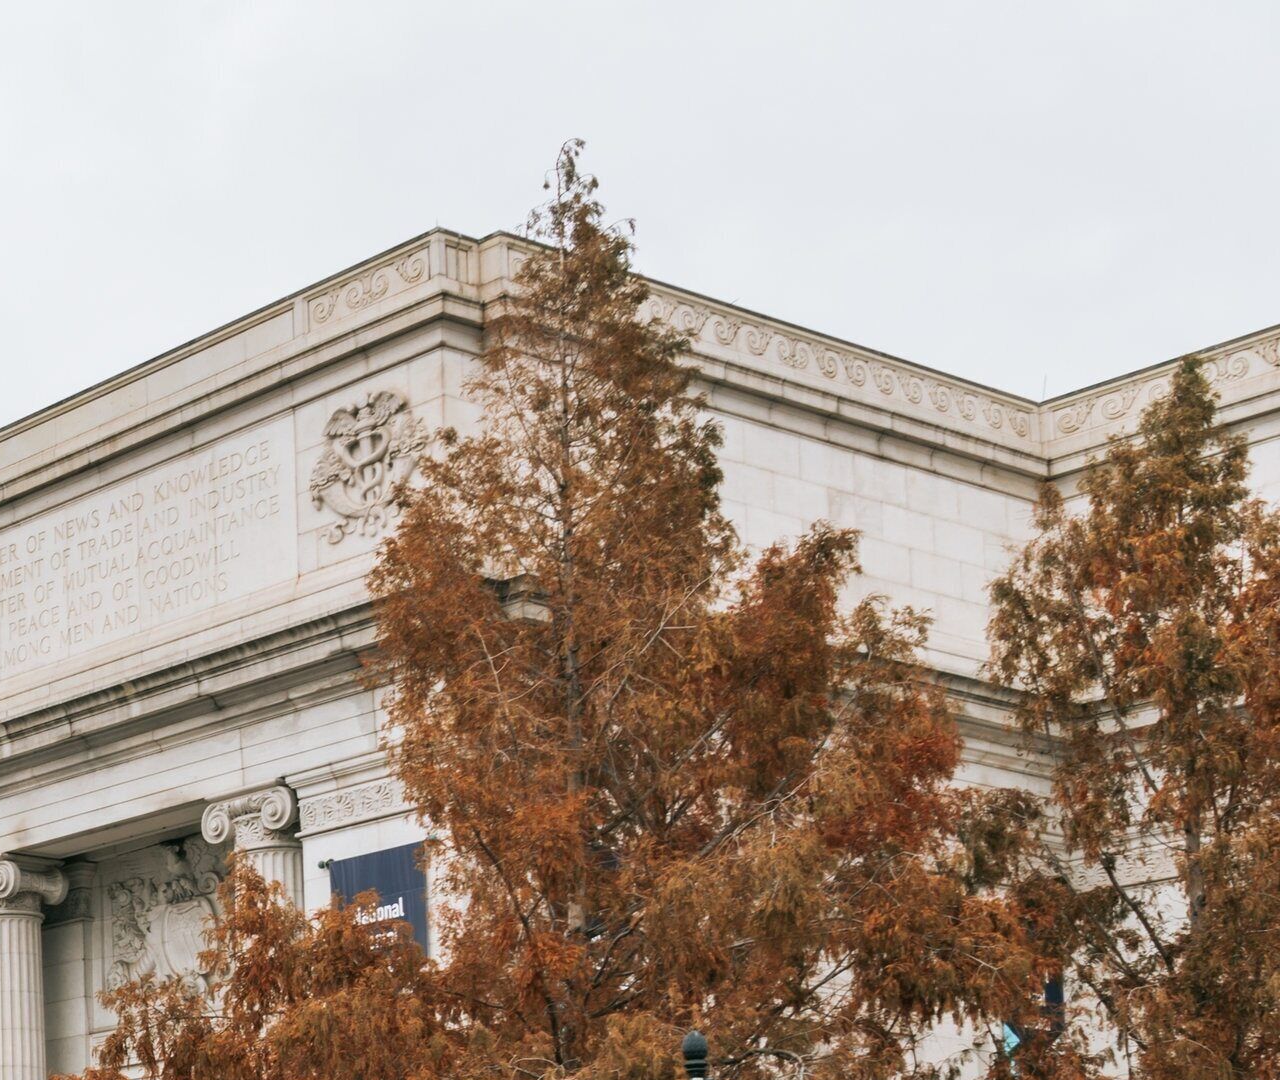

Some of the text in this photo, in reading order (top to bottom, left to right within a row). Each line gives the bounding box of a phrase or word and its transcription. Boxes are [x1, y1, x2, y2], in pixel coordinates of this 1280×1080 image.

[26, 530, 46, 555] OF
[53, 508, 101, 545] NEWS
[107, 492, 144, 523] AND
[153, 440, 272, 504] KNOWLEDGE
[33, 580, 56, 604] OF
[62, 553, 130, 594] MUTUAL
[135, 494, 281, 568] ACQUAINTANCE
[50, 547, 71, 571] OF
[77, 523, 134, 561] TRADE
[140, 506, 180, 537] AND
[190, 464, 281, 518] INDUSTRY
[8, 605, 61, 642] PEACE
[67, 590, 103, 620] AND
[112, 577, 134, 602] OF
[142, 540, 241, 590] GOODWILL
[59, 619, 95, 649] MEN
[102, 605, 139, 634] AND
[149, 571, 229, 617] NATIONS
